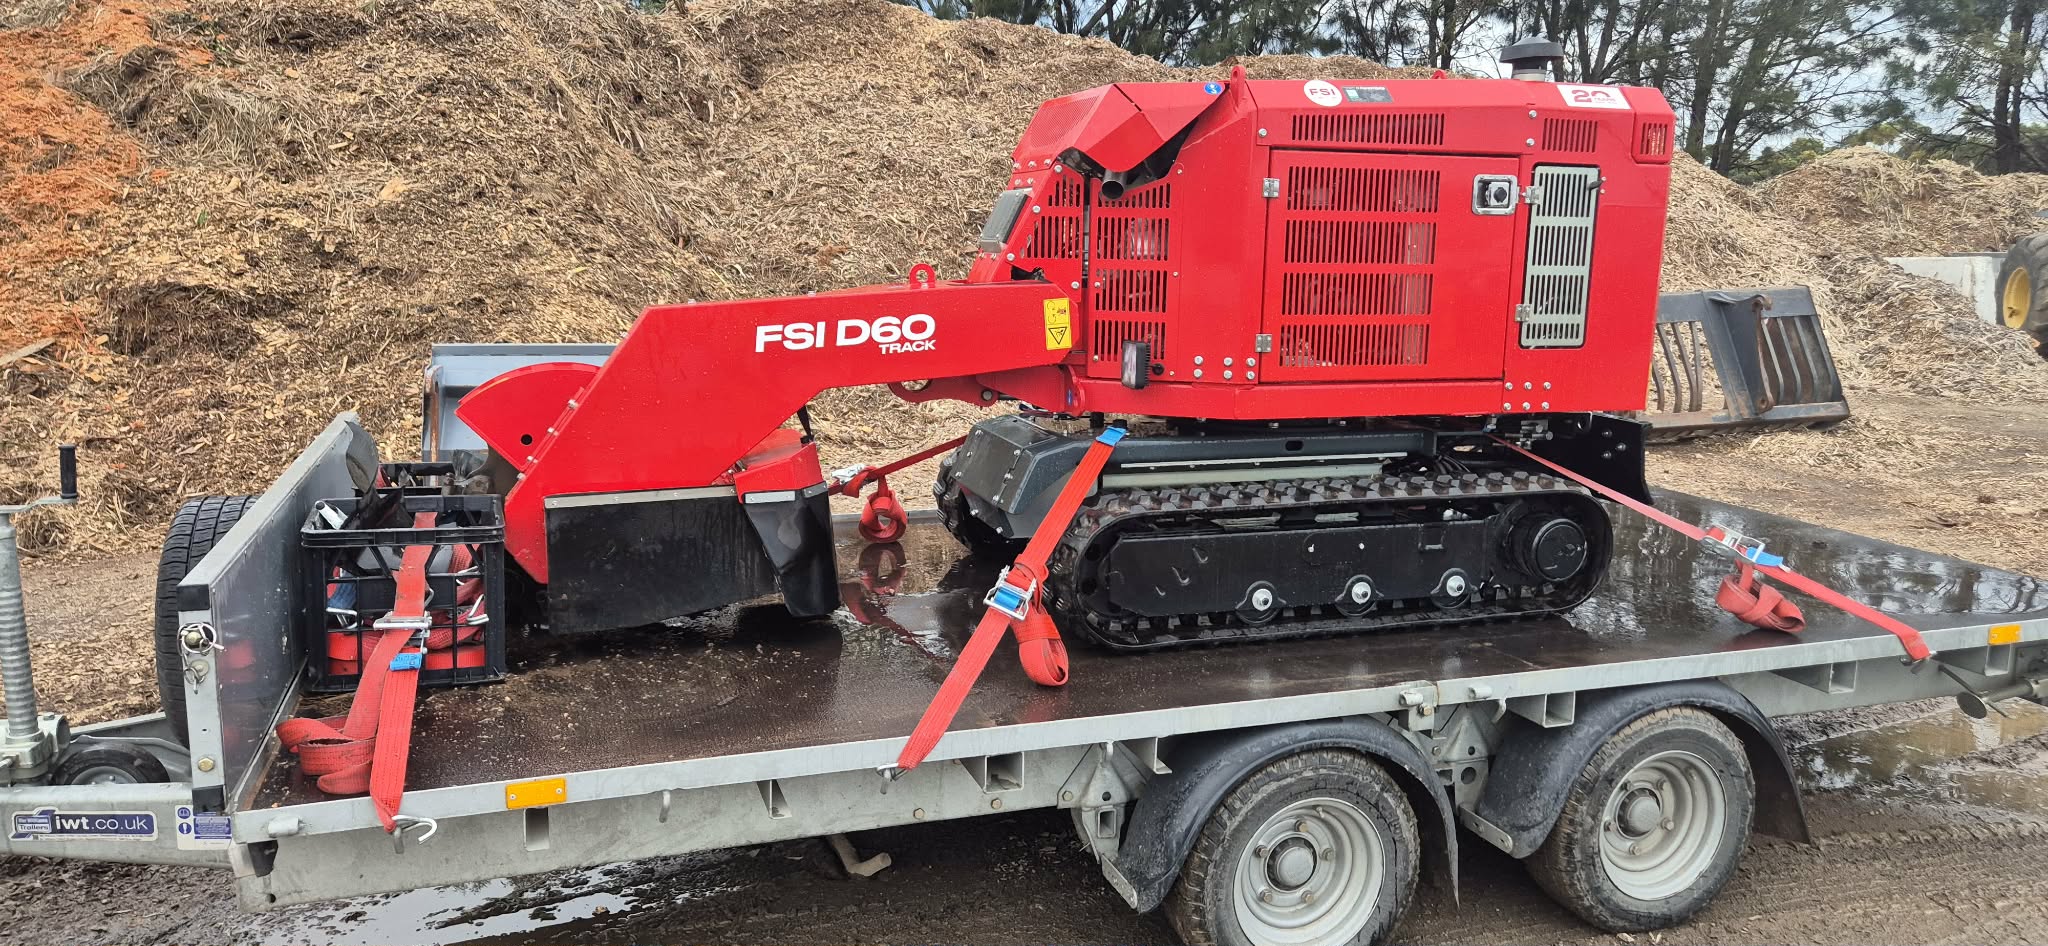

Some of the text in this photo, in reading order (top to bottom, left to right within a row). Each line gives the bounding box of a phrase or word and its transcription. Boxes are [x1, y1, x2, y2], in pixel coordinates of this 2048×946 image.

[1309, 88, 1336, 96] FSI
[755, 313, 936, 353] FSI D60
[878, 339, 936, 355] TRACK
[55, 815, 148, 830] iwt.co.uk
